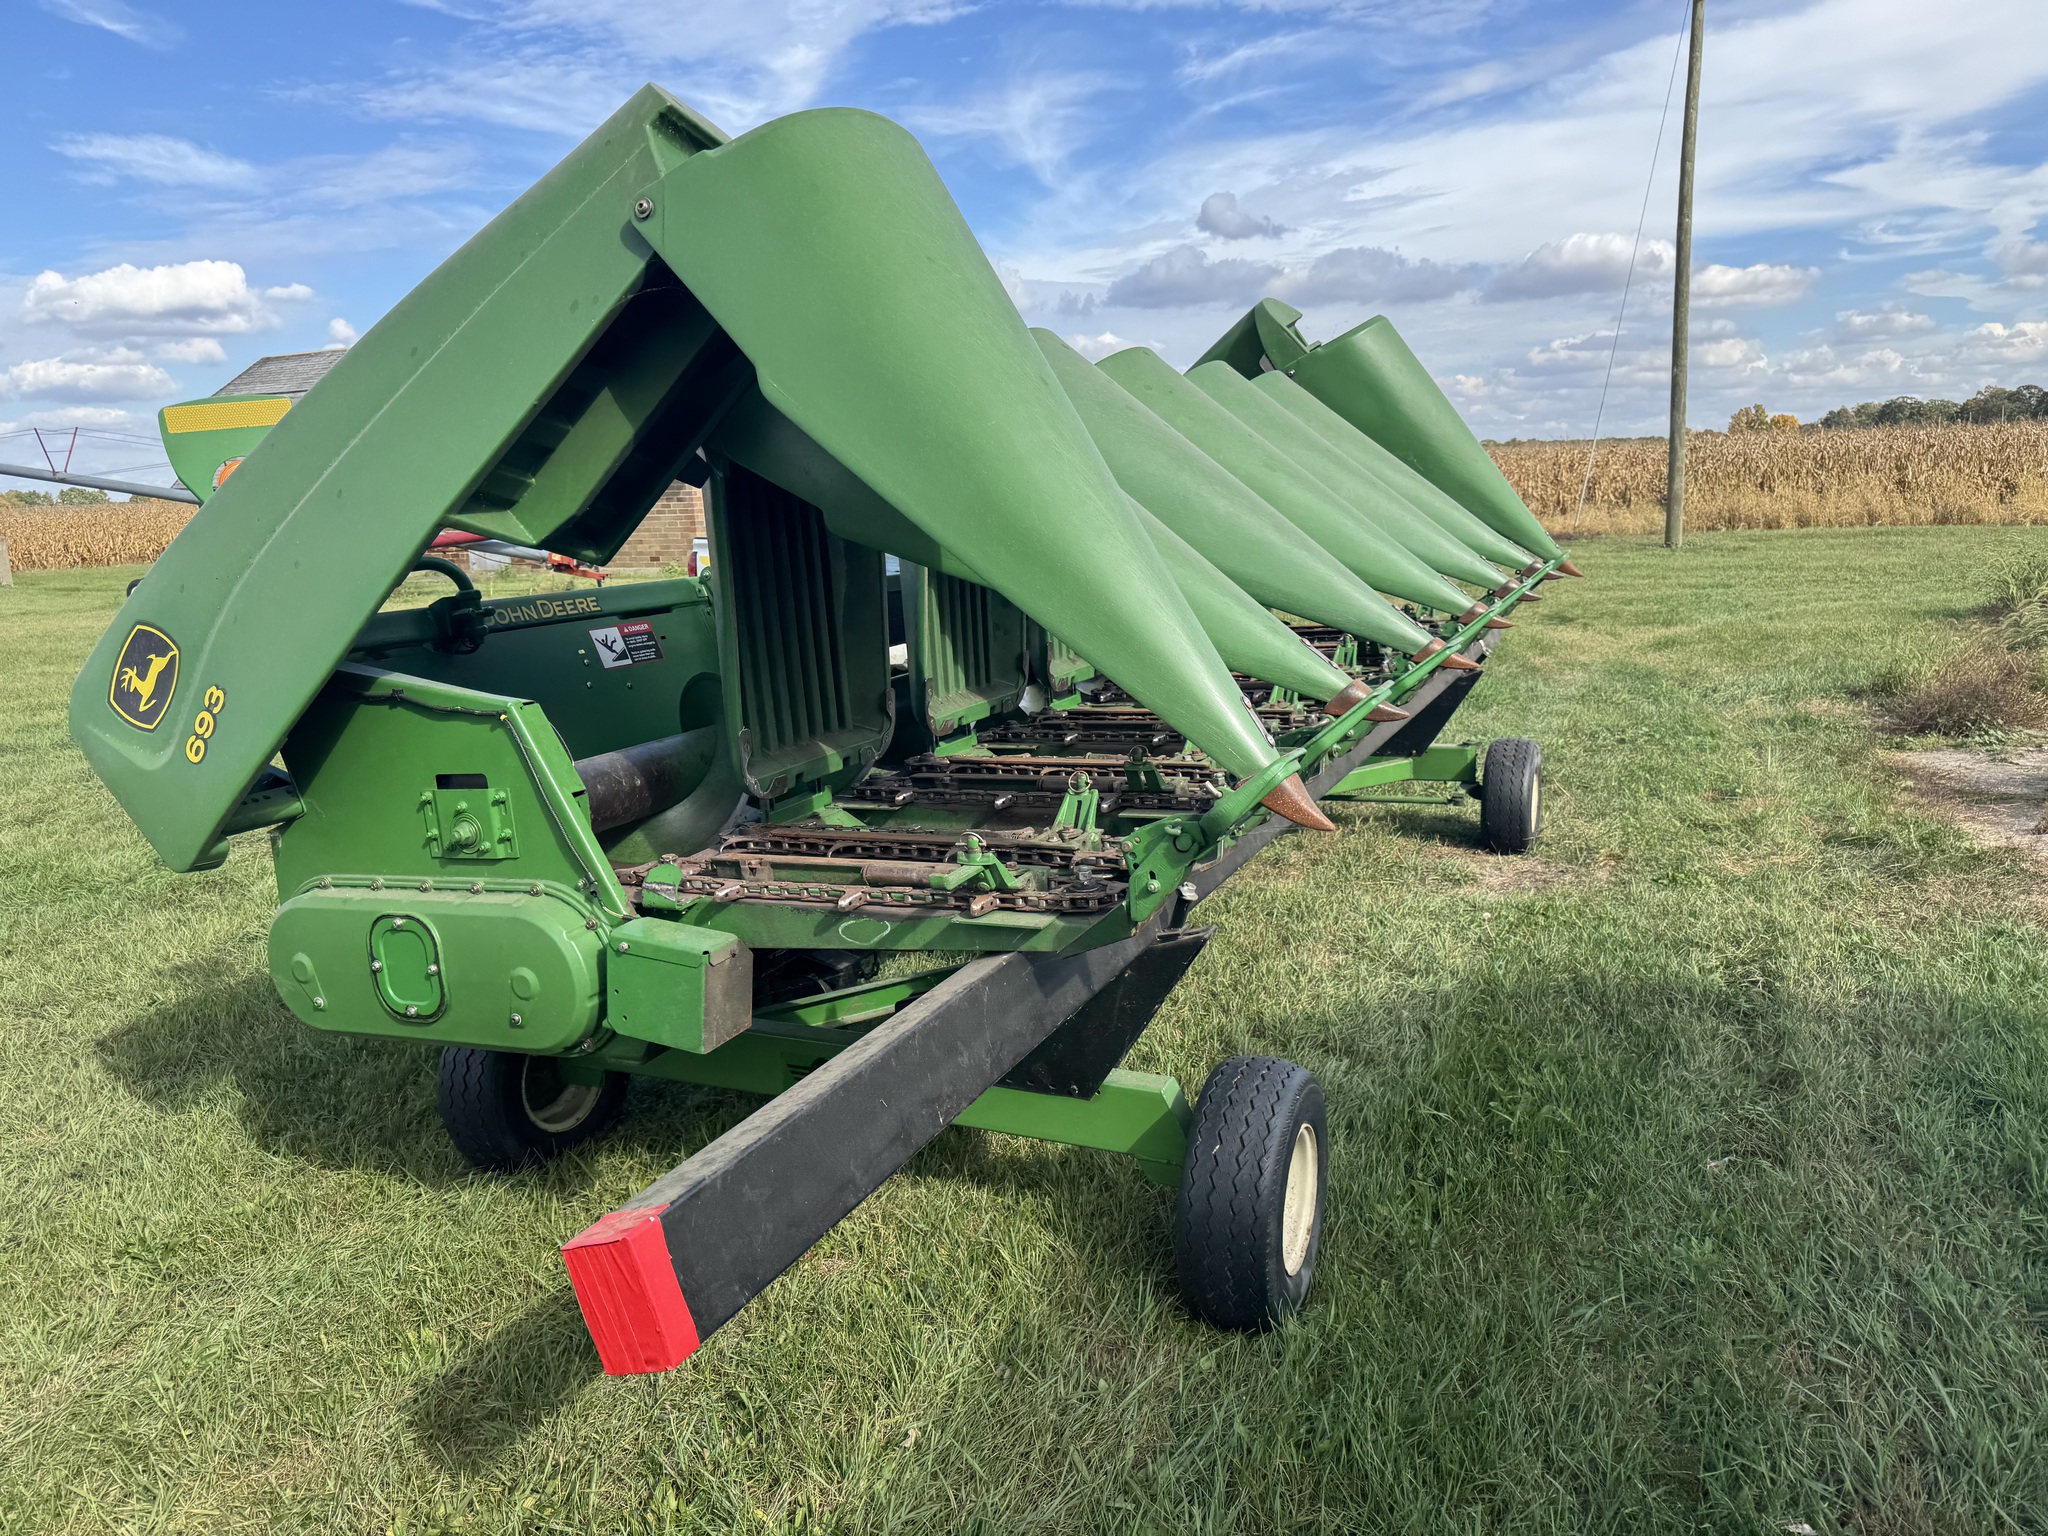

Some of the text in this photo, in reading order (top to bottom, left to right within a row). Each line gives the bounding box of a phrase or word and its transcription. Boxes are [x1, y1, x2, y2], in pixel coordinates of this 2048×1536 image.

[536, 597, 602, 619] DEERE
[628, 623, 649, 632] DANGER
[185, 685, 226, 764] 693
